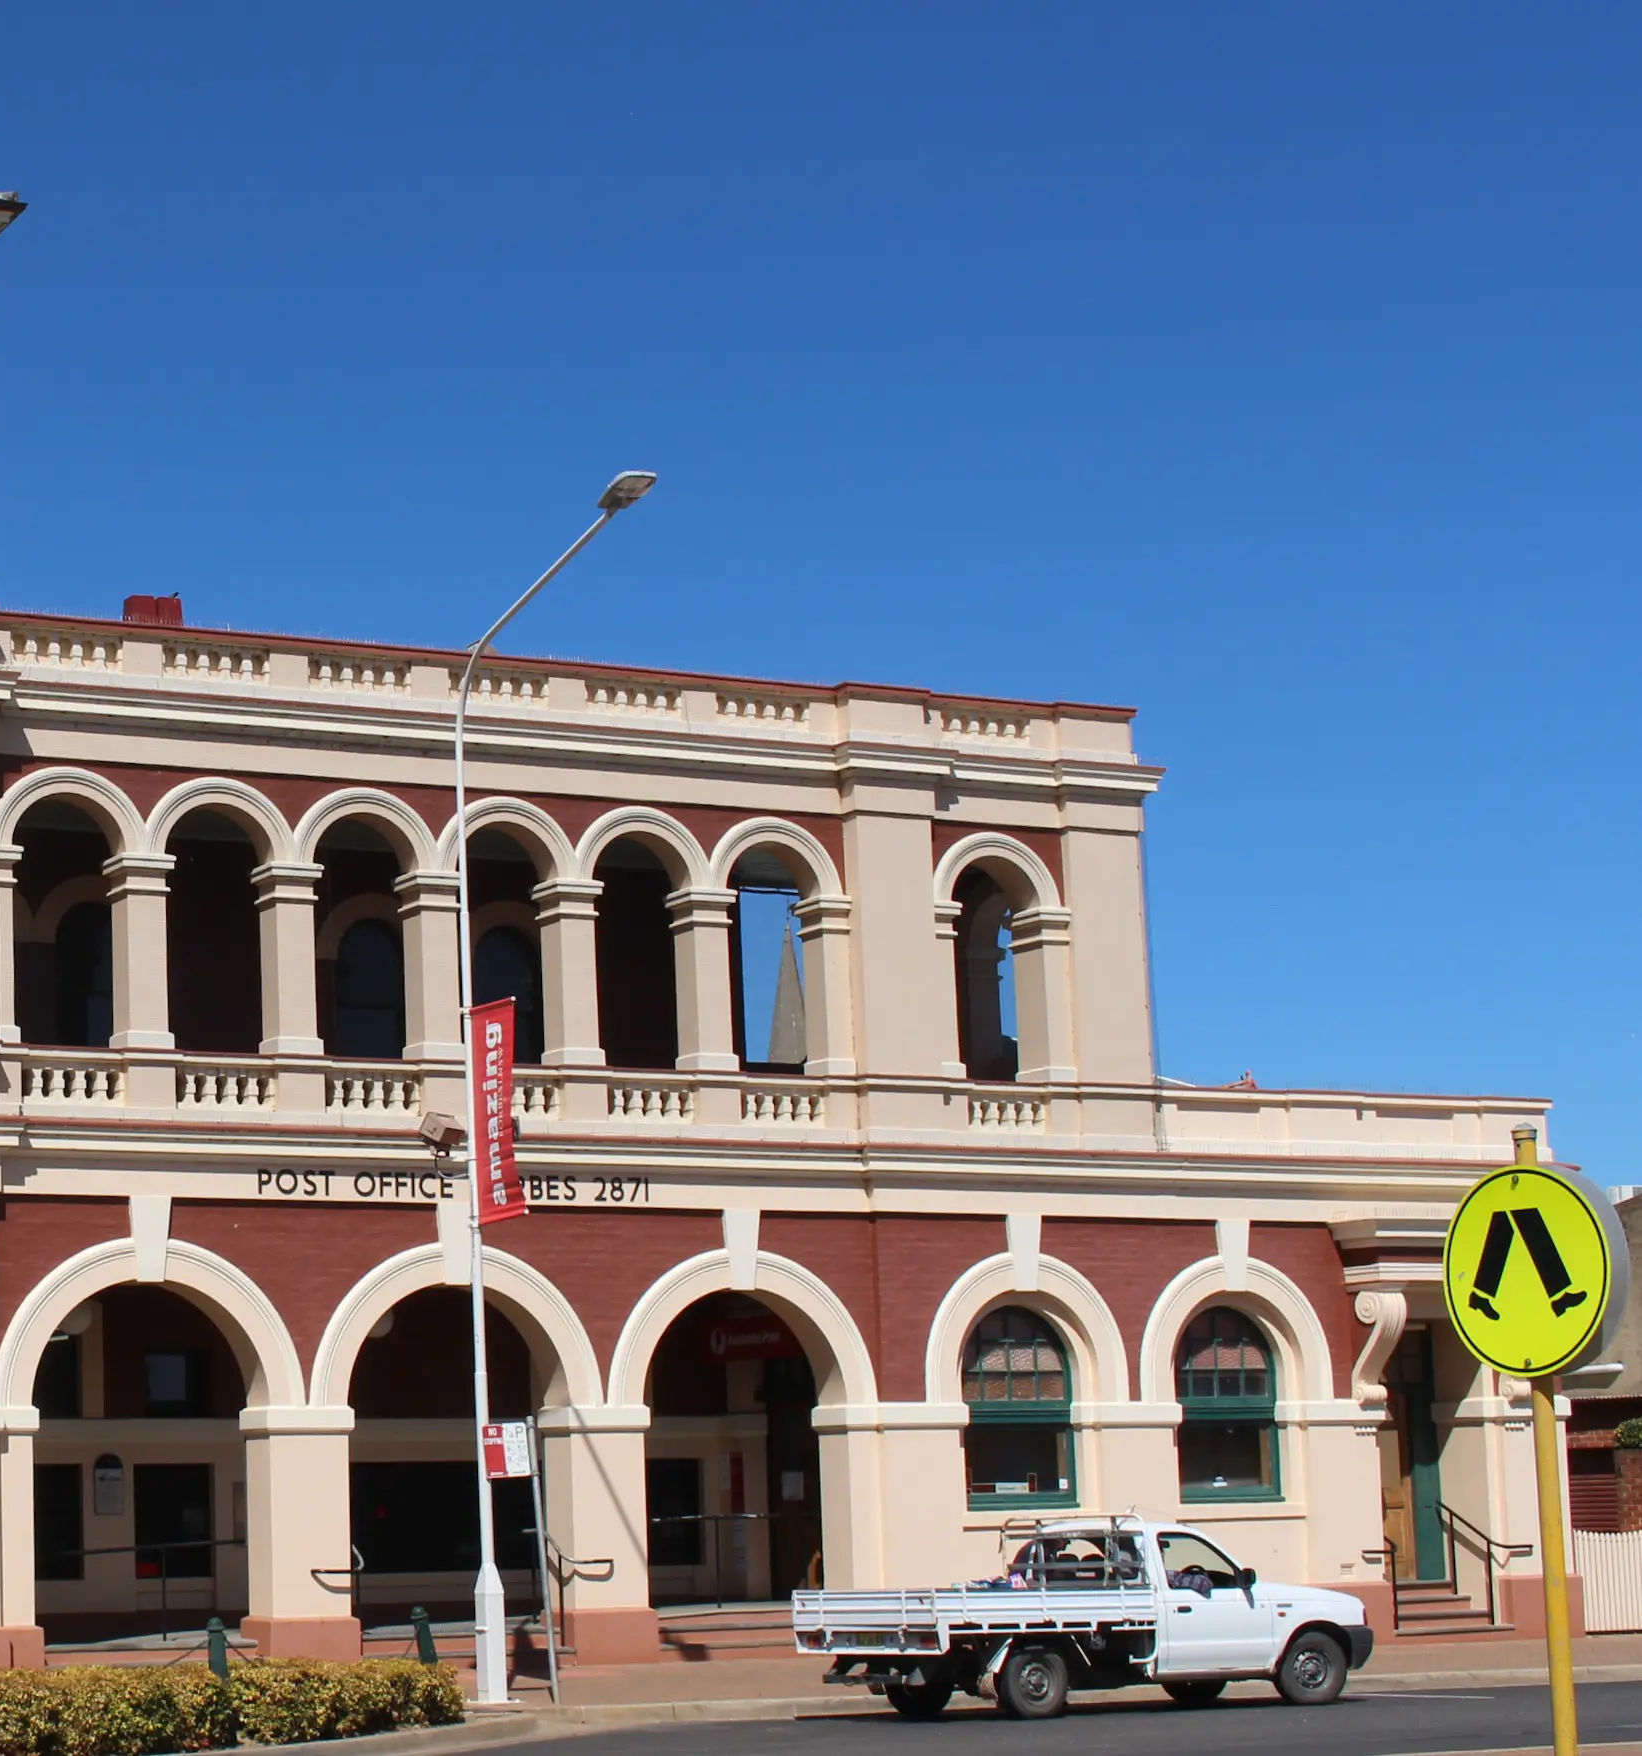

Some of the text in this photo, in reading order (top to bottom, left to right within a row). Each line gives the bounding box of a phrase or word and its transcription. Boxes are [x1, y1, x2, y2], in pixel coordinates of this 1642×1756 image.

[482, 1019, 508, 1207] amazing
[257, 1168, 335, 1196] POST
[353, 1171, 455, 1199] OFFICE
[593, 1176, 649, 1202] 2871
[487, 1427, 497, 1436] NO
